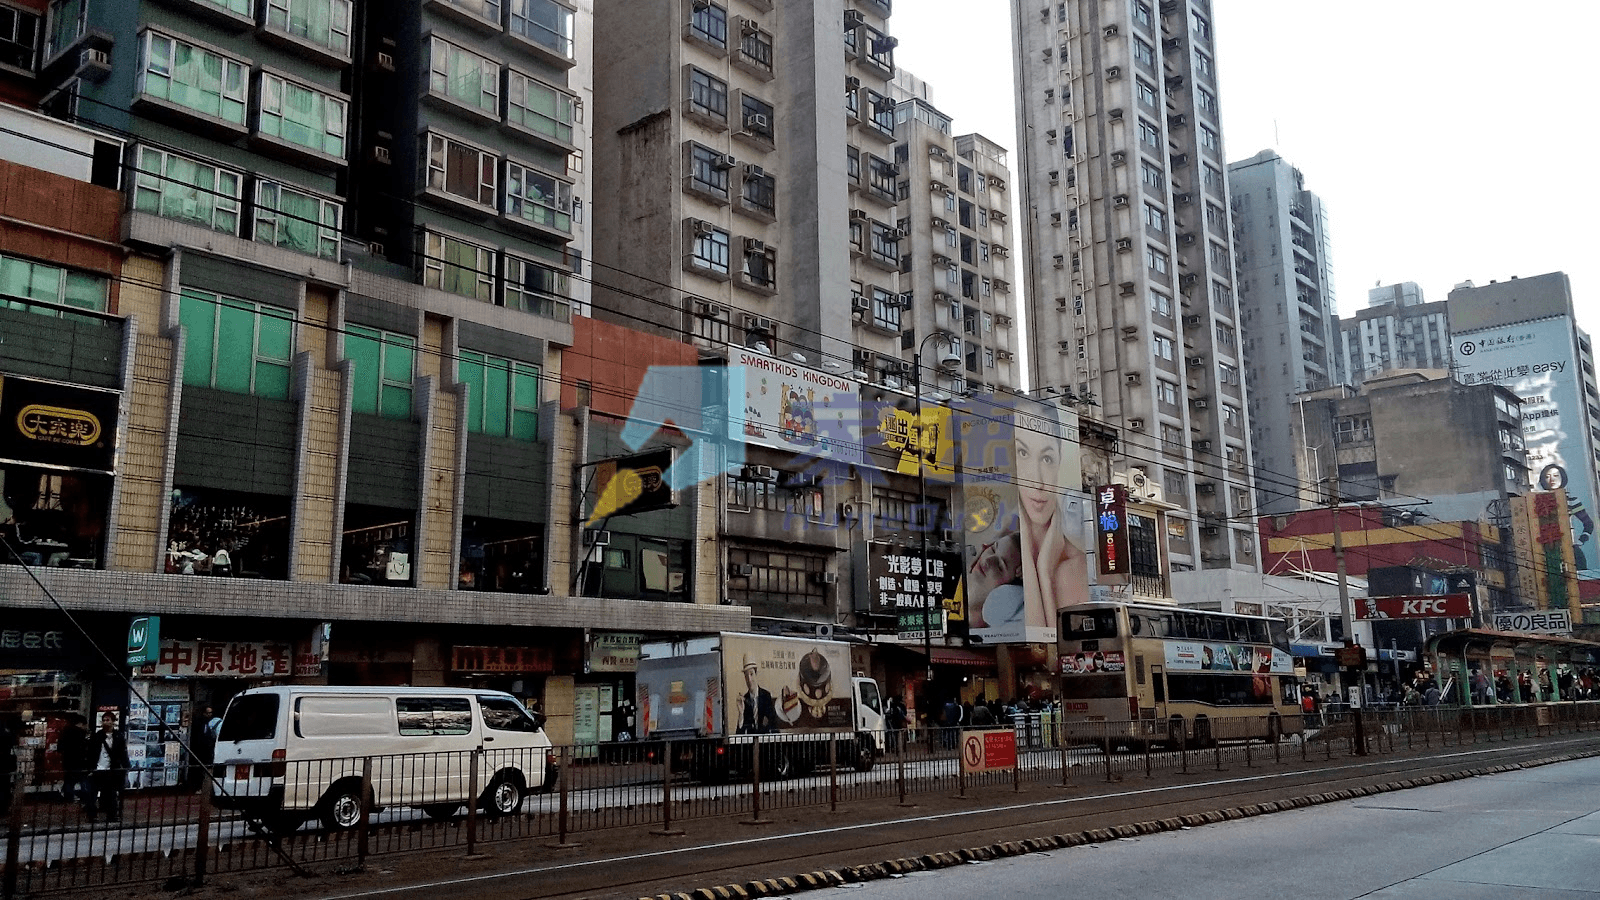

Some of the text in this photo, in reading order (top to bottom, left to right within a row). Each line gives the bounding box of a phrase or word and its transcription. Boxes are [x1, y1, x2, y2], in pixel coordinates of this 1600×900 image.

[740, 354, 850, 392] SMARTKIDS KINGDOM
[1532, 360, 1566, 373] easy
[1401, 599, 1447, 615] KFC
[1495, 613, 1566, 631] 優の良品
[0, 630, 63, 648] 屈臣氏
[160, 641, 291, 677] 中原地產
